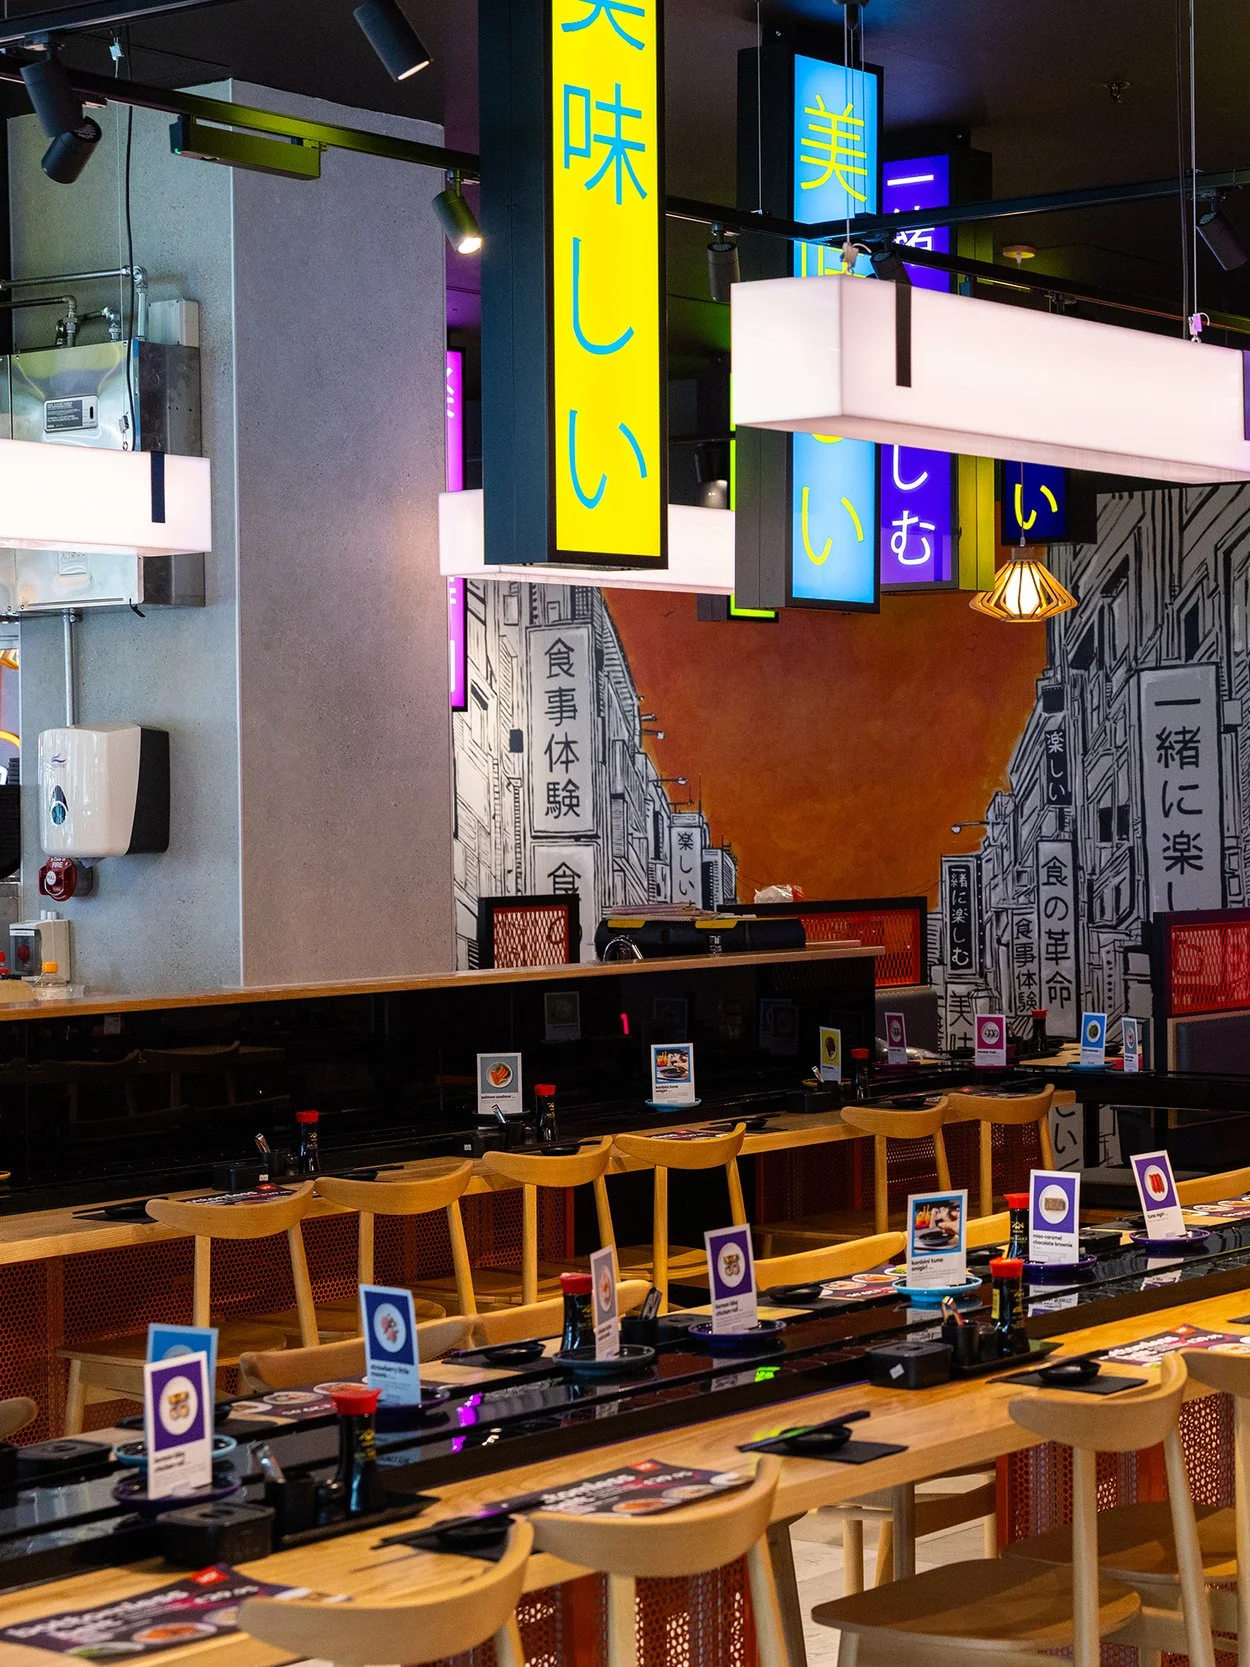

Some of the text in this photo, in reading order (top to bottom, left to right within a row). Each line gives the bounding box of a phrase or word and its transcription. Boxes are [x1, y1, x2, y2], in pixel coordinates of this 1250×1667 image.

[800, 94, 868, 566] 美い
[544, 637, 581, 820] 食事体験
[1046, 731, 1065, 800] 楽しい
[951, 868, 970, 966] 一緒に楽しむ
[1014, 918, 1039, 1012] 食事体験
[1041, 856, 1073, 1009] 食の革命
